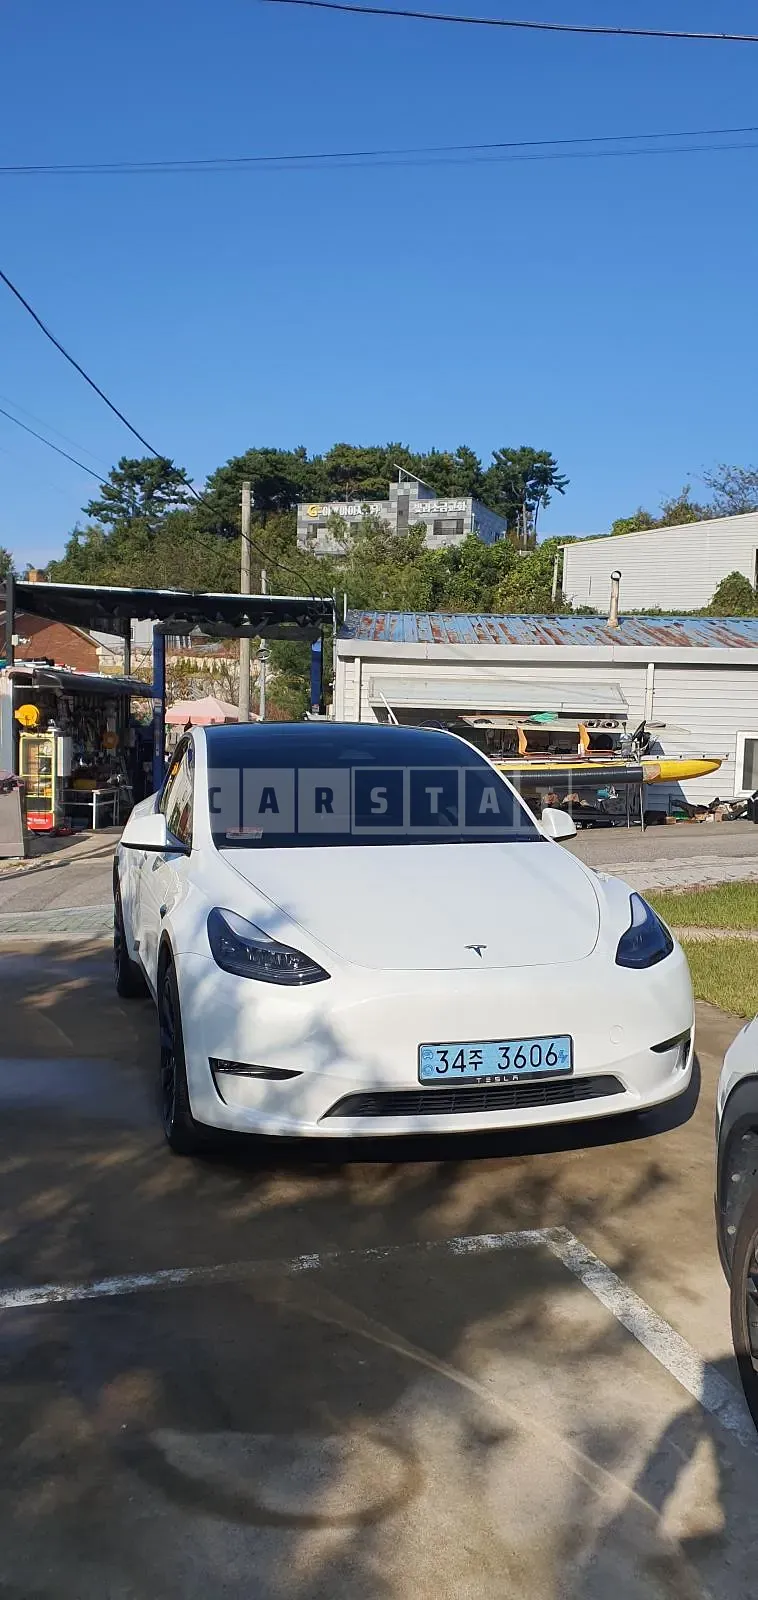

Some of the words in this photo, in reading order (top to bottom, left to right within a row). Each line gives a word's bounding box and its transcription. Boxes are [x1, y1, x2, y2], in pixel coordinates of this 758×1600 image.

[435, 1048, 484, 1074] 34주
[497, 1043, 558, 1071] 3606
[475, 1075, 519, 1084] TESLA
